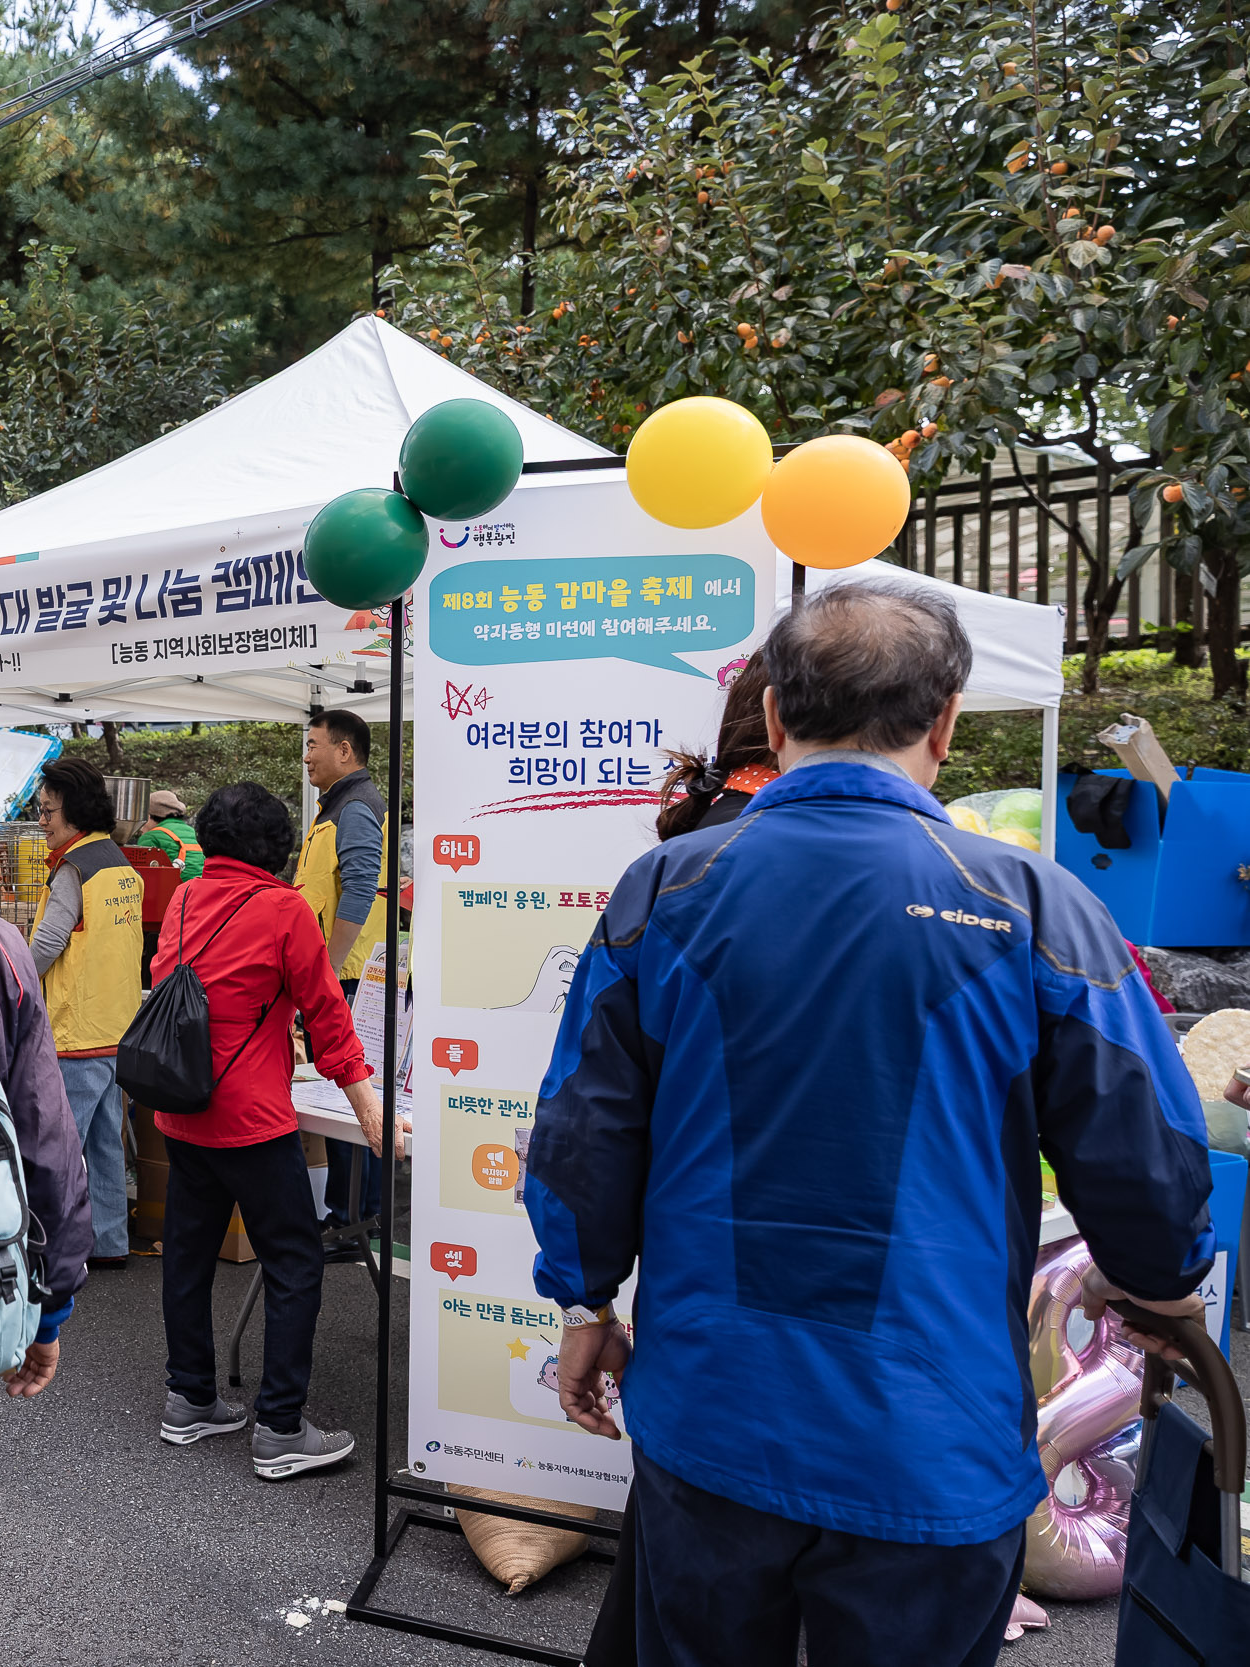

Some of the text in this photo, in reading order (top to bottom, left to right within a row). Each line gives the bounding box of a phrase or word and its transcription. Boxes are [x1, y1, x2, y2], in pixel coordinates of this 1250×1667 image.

[473, 531, 515, 547] 행복광진
[34, 581, 95, 633] 발굴
[97, 574, 132, 626] 및
[135, 568, 203, 620] 나눔
[441, 575, 741, 613] 제8회 능동 감마을 축제 에서
[473, 614, 717, 642] 약자동행 미선에 참여해주세요.
[111, 623, 318, 665] [능동 지역사회보장협의체]
[466, 719, 663, 749] 여러분의 참여가
[508, 756, 586, 786] 희망이
[597, 756, 651, 786] 되는
[440, 839, 475, 859] 하나
[458, 889, 611, 912] 캠페인 응원, 포토존
[445, 1043, 464, 1063] 둘
[448, 1095, 533, 1119] 따뜻한 관심,
[442, 1298, 559, 1329] 아는 만큼 돕는다,
[443, 1443, 504, 1464] 능동주민센터
[537, 1461, 628, 1485] 능동지역사회보장협의체
